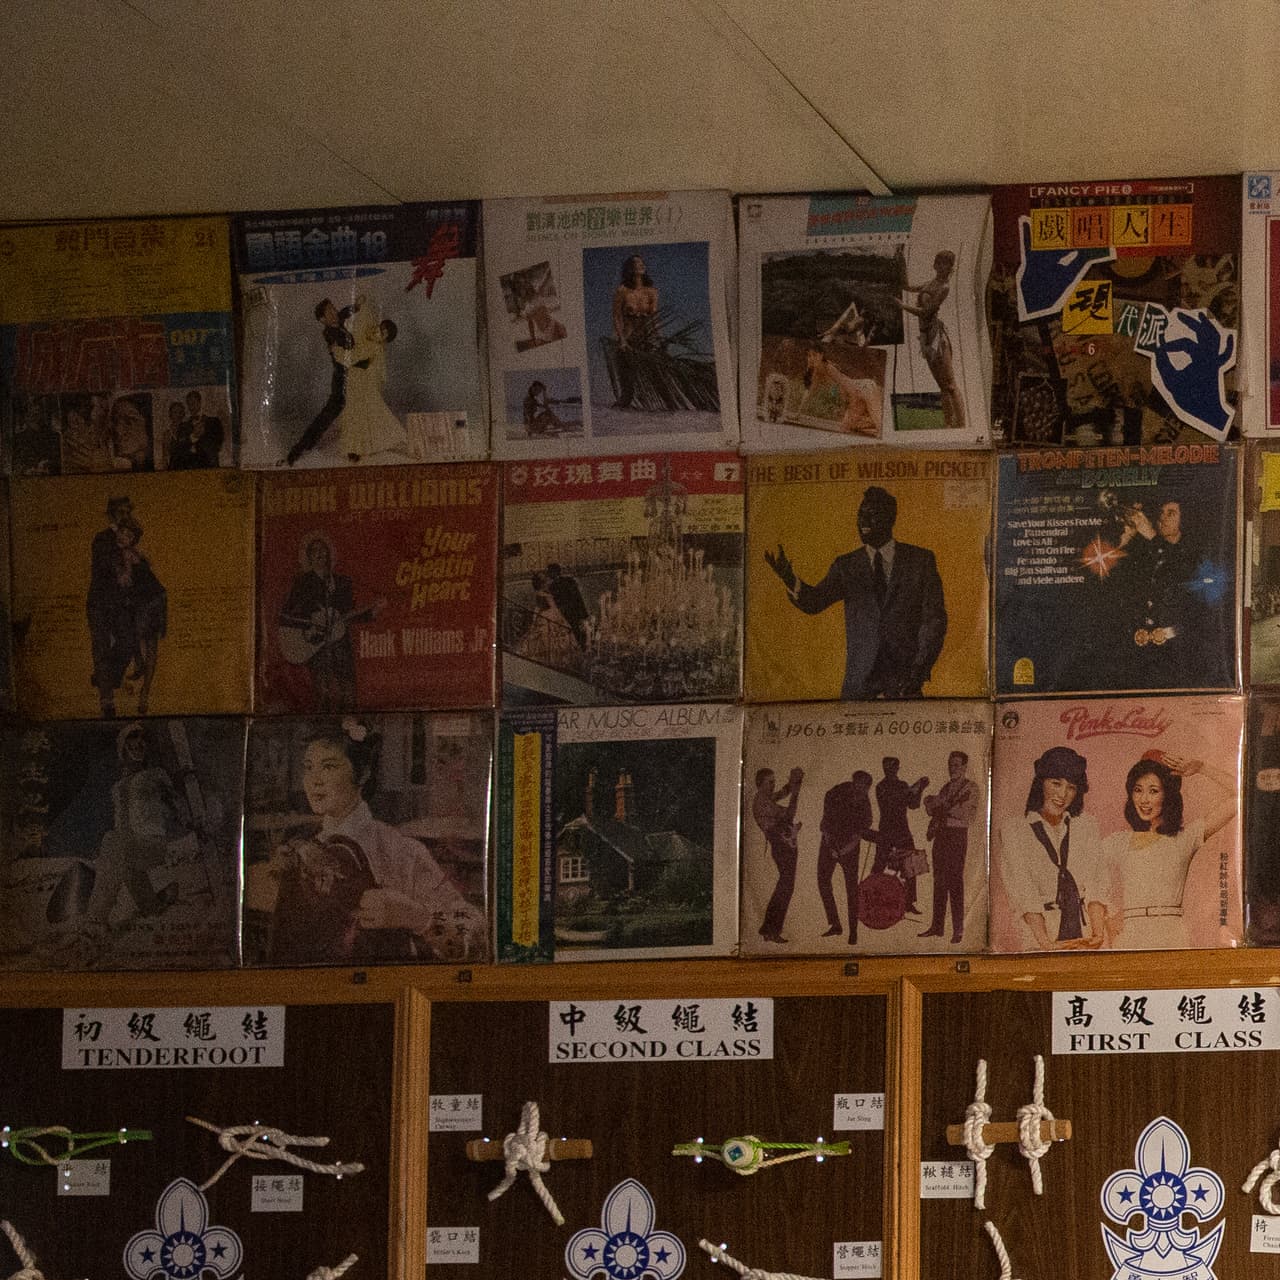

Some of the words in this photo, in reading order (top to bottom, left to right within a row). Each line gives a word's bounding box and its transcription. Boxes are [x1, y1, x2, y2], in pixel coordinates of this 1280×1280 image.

[1037, 186, 1090, 196] FANCY
[748, 464, 774, 483] THE
[784, 462, 824, 481] BEST
[830, 461, 851, 480] OF
[857, 460, 918, 480] WILSON
[923, 459, 989, 478] PICKETT
[421, 525, 477, 558] Your
[411, 580, 471, 611] Heart
[588, 709, 647, 728] MUSIC
[655, 707, 719, 725] ALBUM
[1059, 706, 1114, 740] Pink
[1115, 706, 1174, 738] Lady
[785, 722, 827, 738] 1966
[560, 1002, 760, 1036] 中級繩結
[1065, 992, 1267, 1028] 高級繩結
[75, 1011, 270, 1043] 初級繩結
[555, 1039, 667, 1060] SECOND
[676, 1038, 761, 1057] CLASS
[1069, 1032, 1151, 1052] FIRST
[1174, 1030, 1263, 1049] CLASS
[78, 1046, 266, 1067] TENDERFOOT
